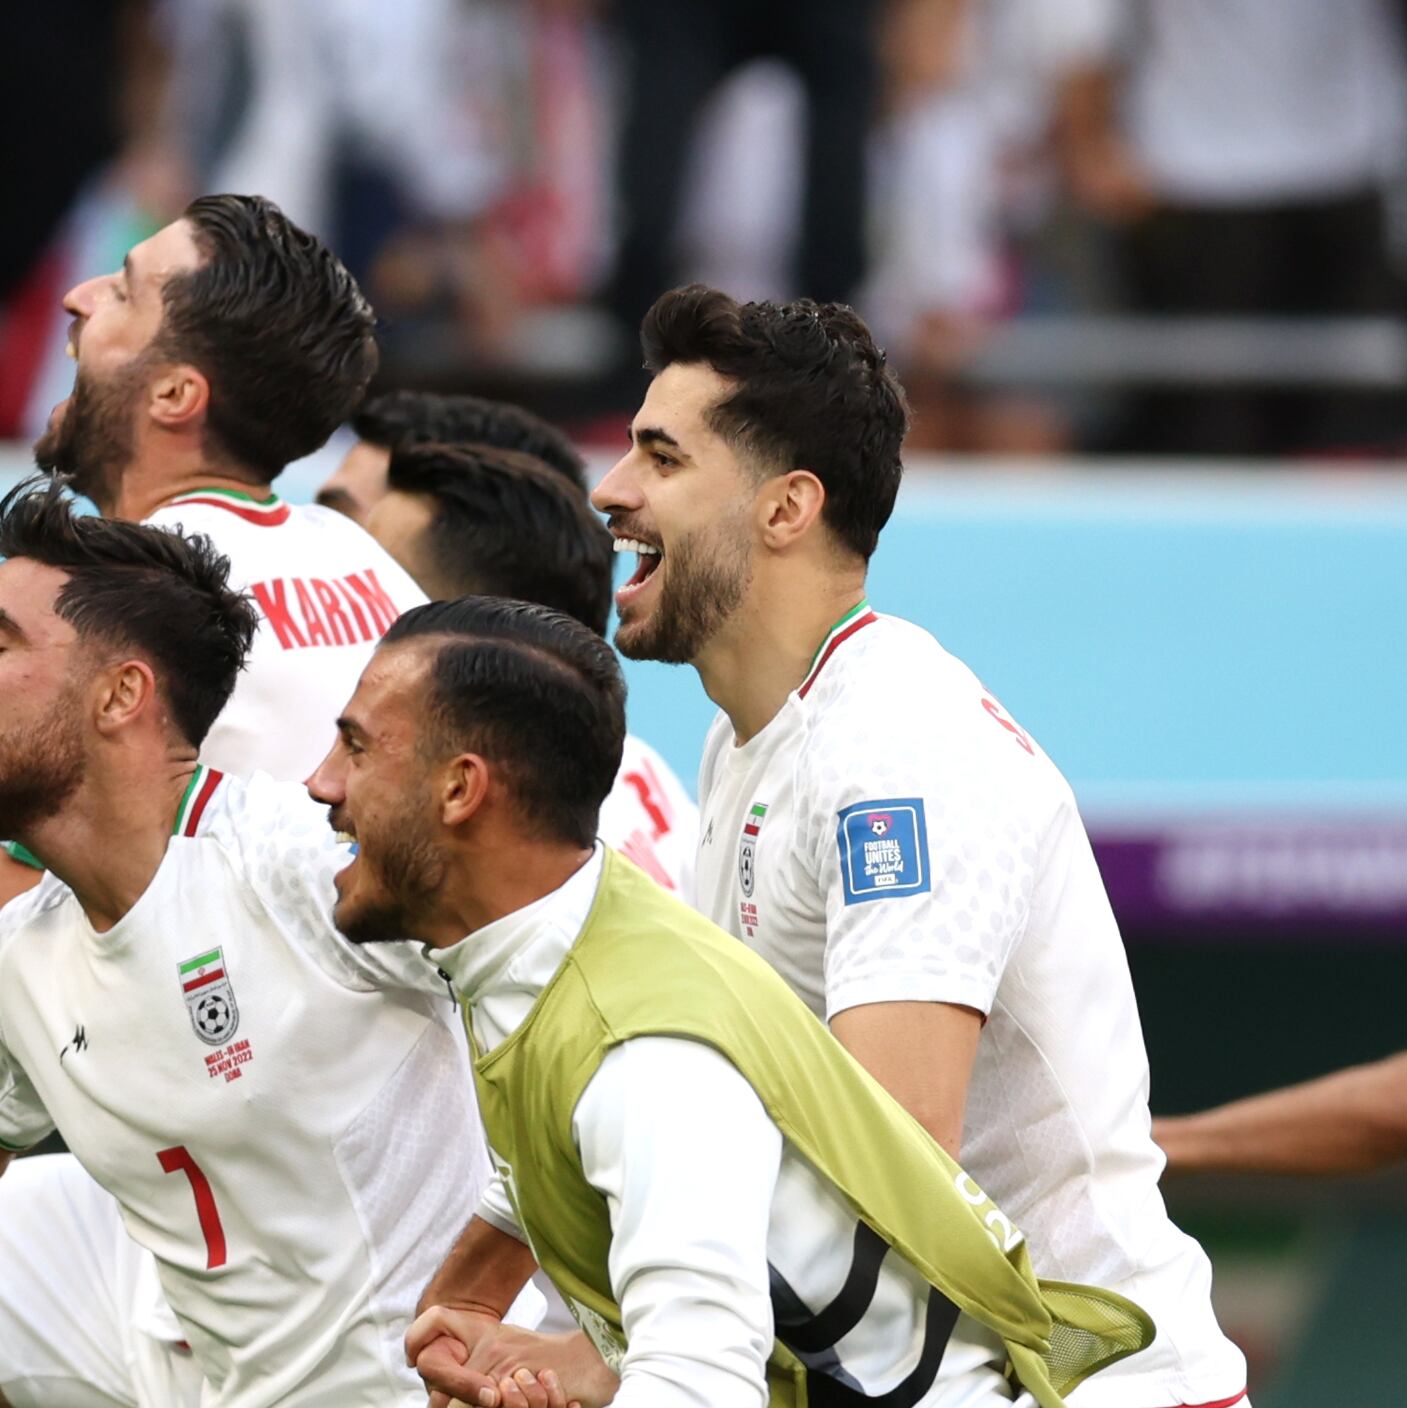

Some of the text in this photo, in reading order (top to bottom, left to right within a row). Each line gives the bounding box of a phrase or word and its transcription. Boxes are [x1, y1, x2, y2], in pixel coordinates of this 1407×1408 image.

[864, 839, 899, 852] FOOTBALL
[865, 848, 901, 865] UNITES
[232, 1050, 254, 1066] 2022
[155, 1145, 227, 1270] 7
